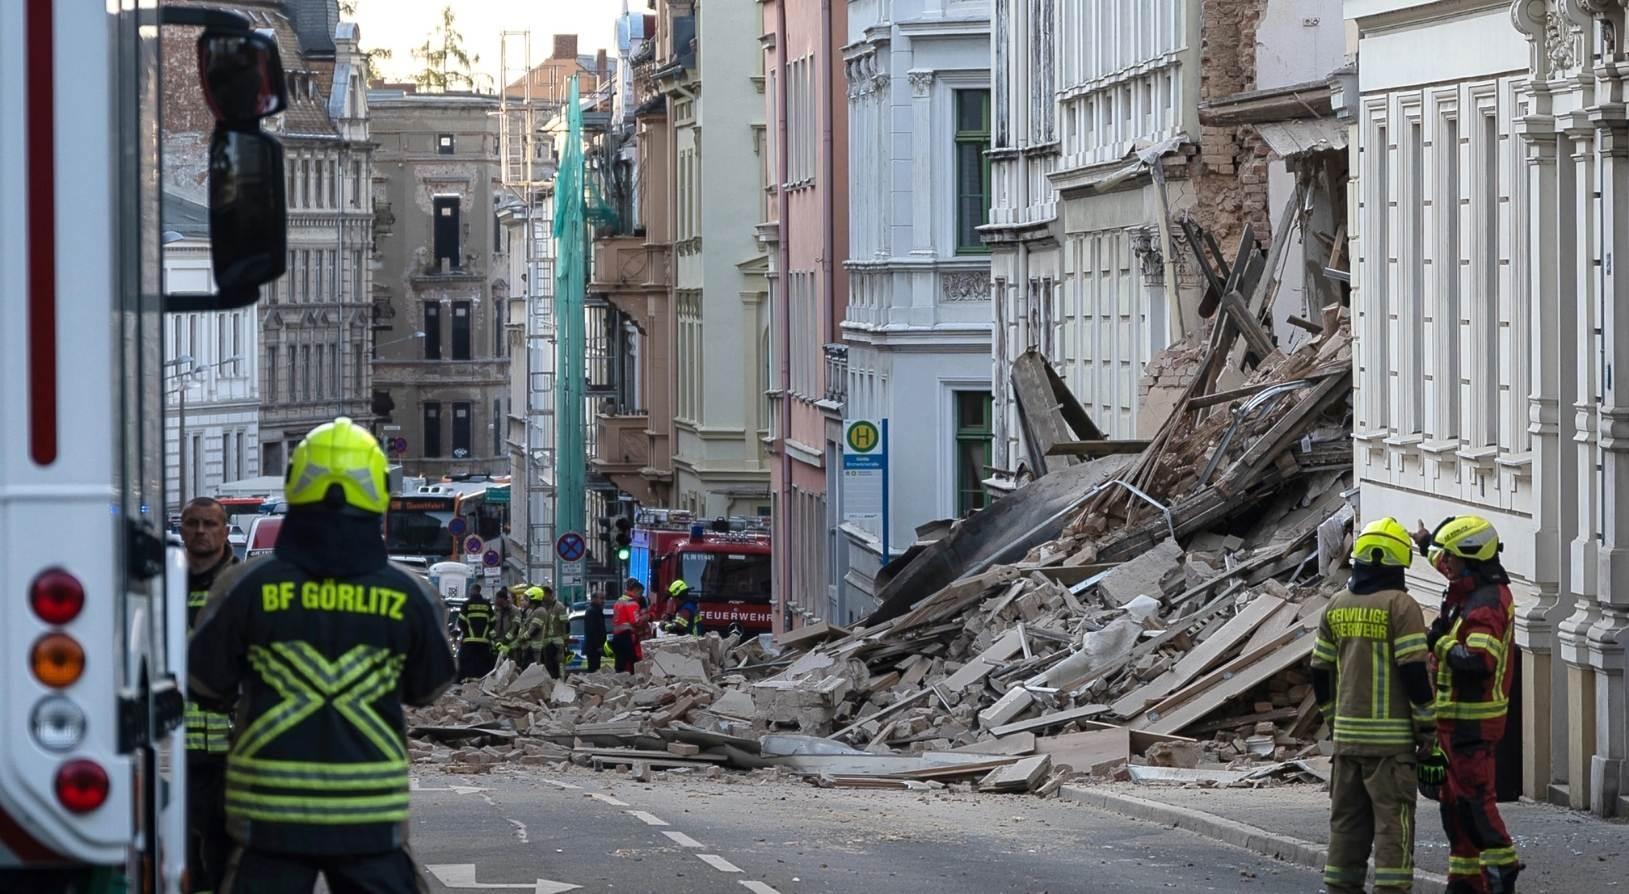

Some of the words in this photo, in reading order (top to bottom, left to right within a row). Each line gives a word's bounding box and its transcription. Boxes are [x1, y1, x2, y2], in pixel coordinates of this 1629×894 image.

[856, 427, 869, 446] H
[261, 581, 296, 612] BF
[301, 578, 408, 621] GÖRLITZ
